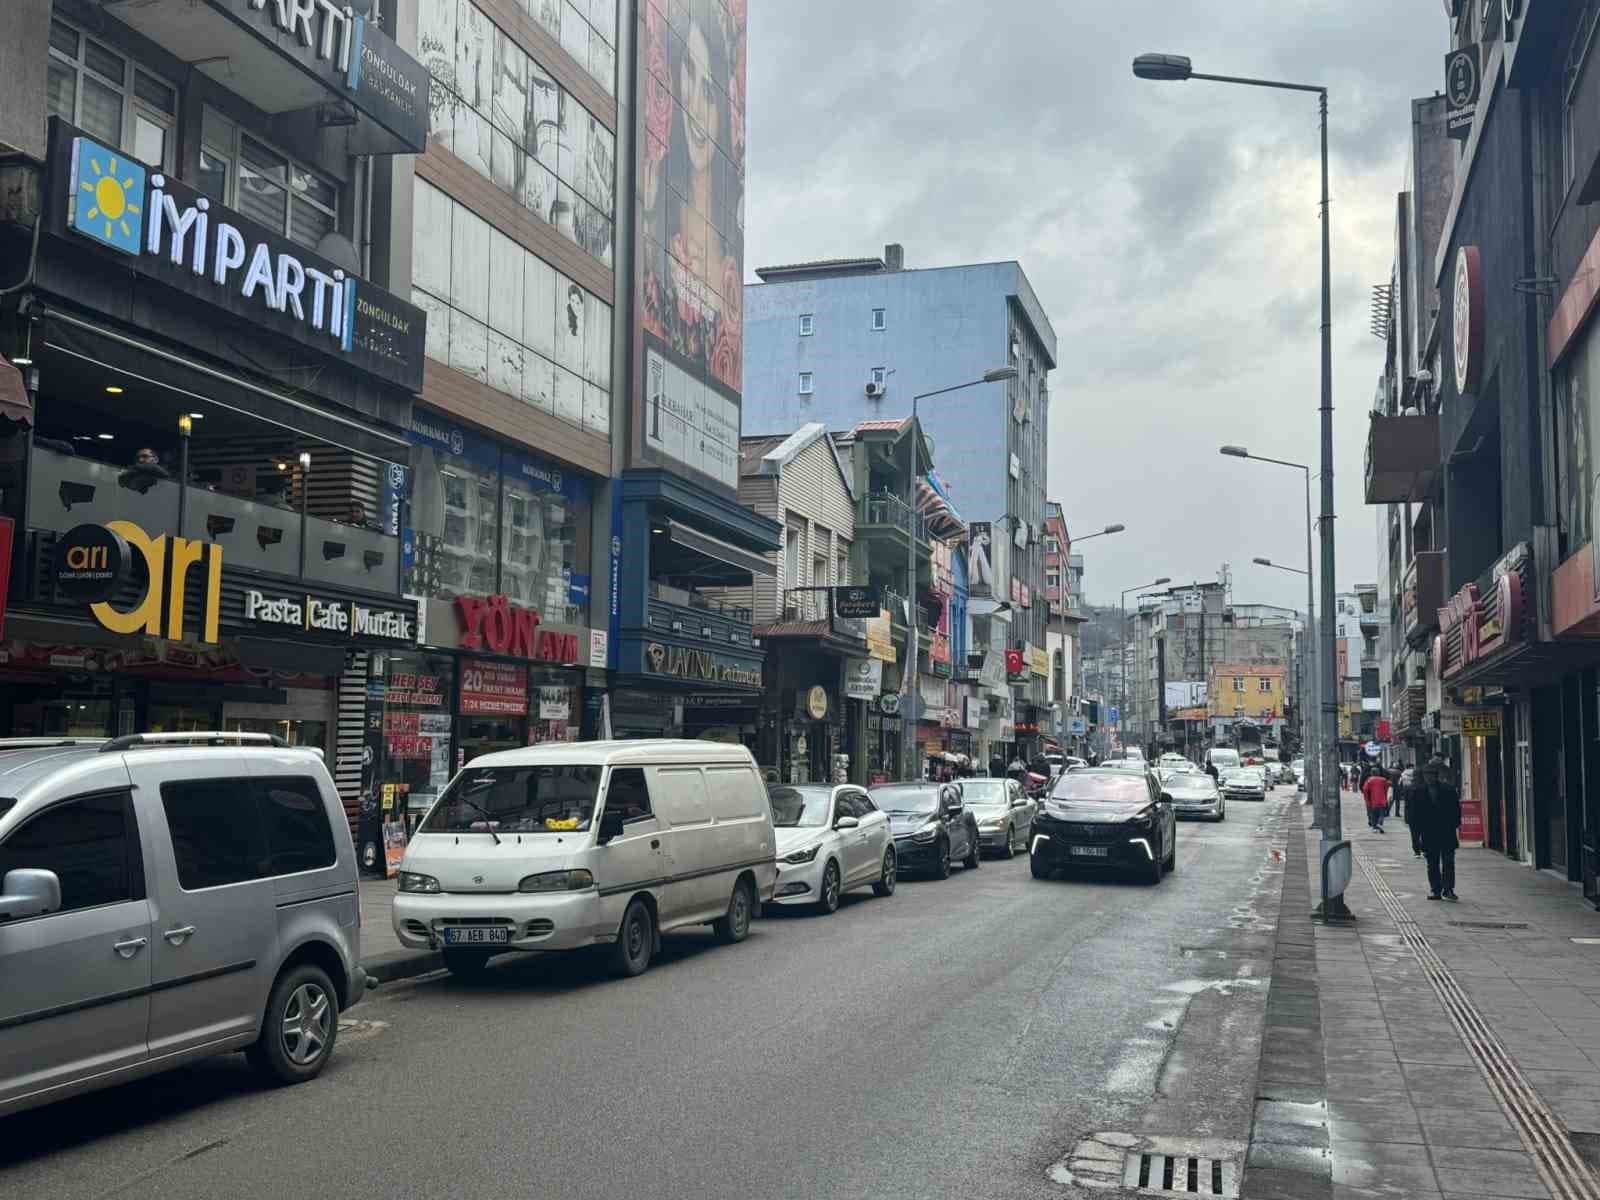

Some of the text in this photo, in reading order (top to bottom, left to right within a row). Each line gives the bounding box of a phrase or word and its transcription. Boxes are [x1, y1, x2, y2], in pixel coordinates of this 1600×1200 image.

[148, 174, 345, 339] İYİ PARTİ
[357, 298, 410, 337] ZONGULDAK
[246, 590, 302, 626] Pasta
[309, 602, 349, 632] Cafe
[354, 604, 412, 640] Mutfak
[456, 594, 541, 658] YÖN
[541, 632, 578, 662] AVM
[463, 669, 481, 691] 20
